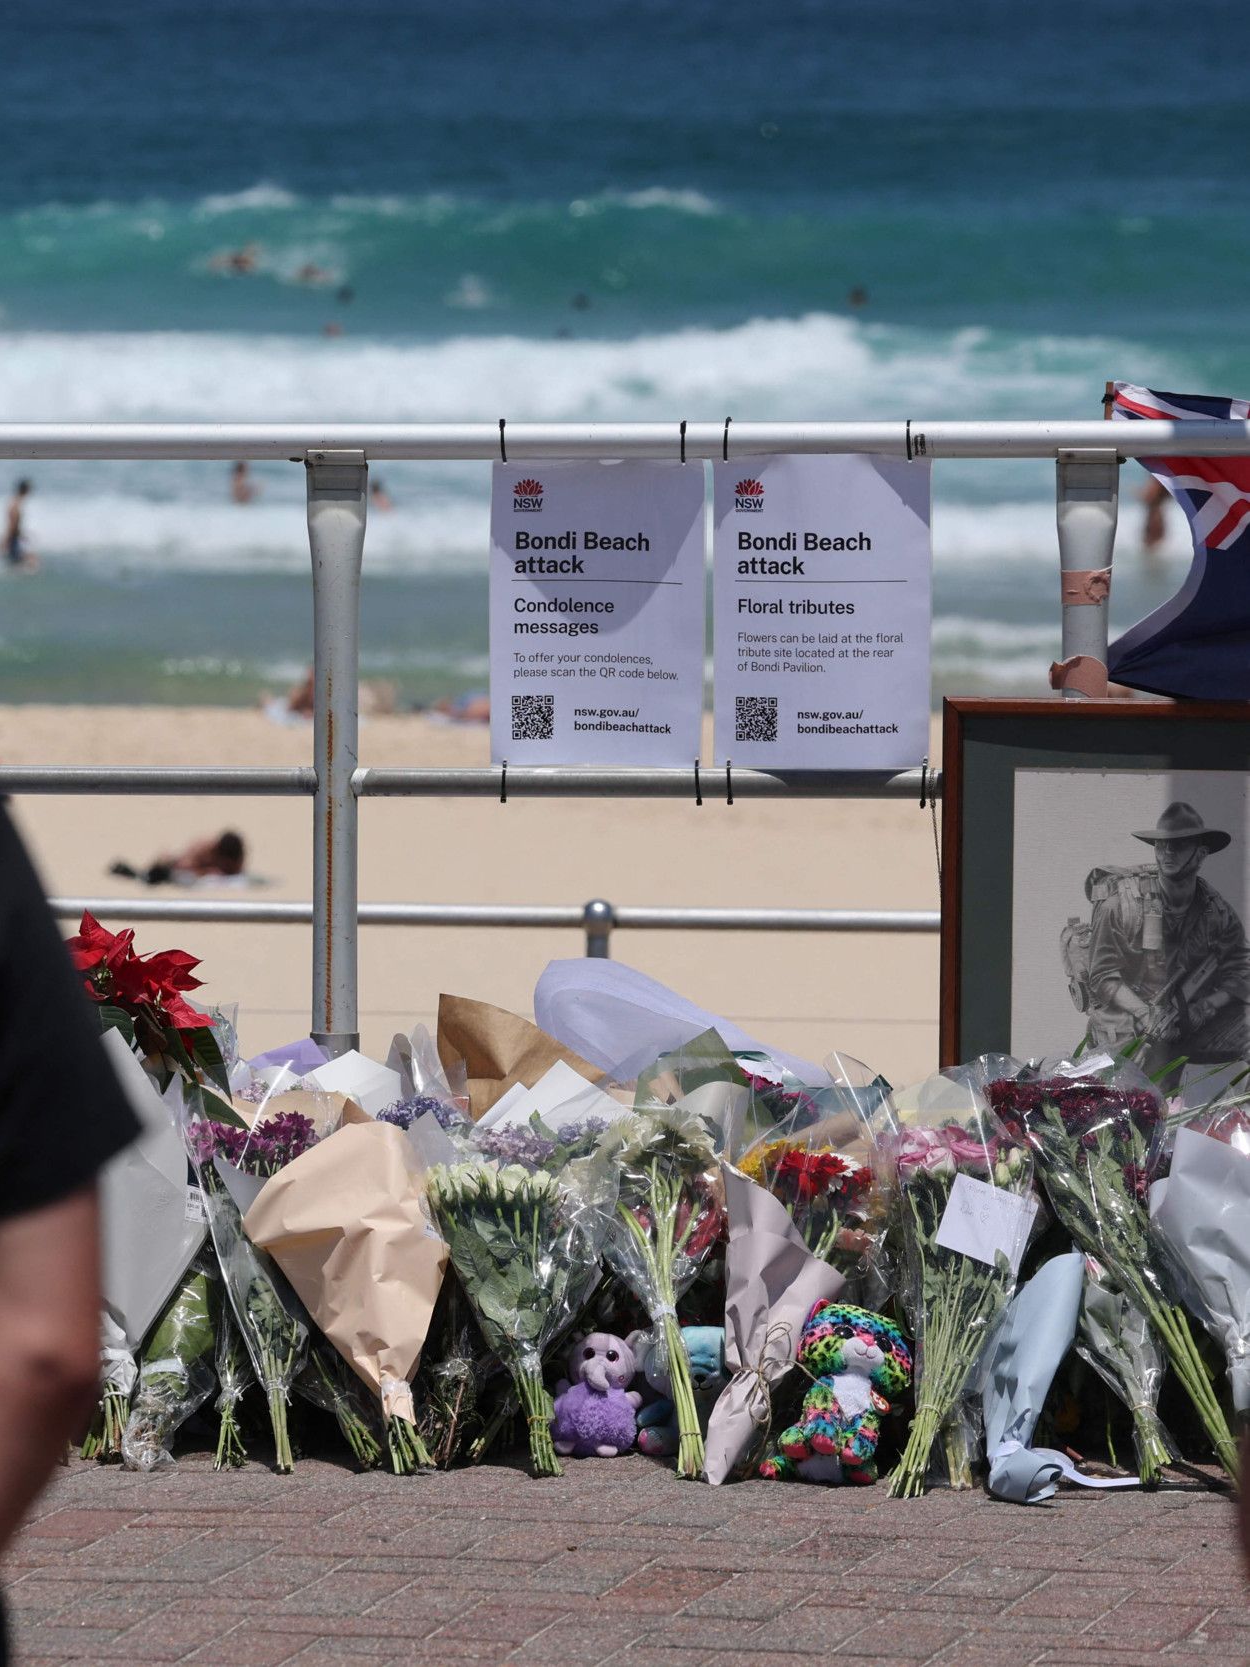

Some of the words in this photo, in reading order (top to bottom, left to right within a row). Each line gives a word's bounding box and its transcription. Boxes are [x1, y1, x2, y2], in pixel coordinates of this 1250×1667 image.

[514, 498, 543, 508] NSW
[736, 498, 764, 508] NSW
[515, 531, 577, 550] Bondi
[584, 532, 650, 551] Beach
[738, 532, 797, 550] Bondi
[804, 532, 871, 551] Beach
[514, 555, 584, 573] attack
[737, 556, 805, 575] attack
[514, 597, 614, 613] Condolence
[738, 598, 783, 614] Floral
[789, 599, 855, 615] tributes
[514, 622, 599, 637] messages
[737, 632, 777, 643] Flowers
[780, 635, 799, 643] can
[802, 633, 815, 643] be
[818, 633, 838, 643] laid
[841, 634, 852, 643] at
[855, 633, 873, 643] the
[876, 633, 904, 643] floral
[513, 652, 526, 663] To
[528, 652, 554, 663] offer
[557, 655, 581, 664] your
[584, 653, 653, 665] condolences,
[738, 647, 771, 657] tribute
[774, 648, 792, 657] site
[795, 648, 835, 658] located
[838, 649, 849, 658] at
[852, 648, 870, 658] the
[873, 649, 894, 658] rear
[513, 667, 548, 679] please
[550, 669, 576, 677] scan
[579, 667, 597, 677] the
[599, 667, 616, 679] QR
[618, 669, 645, 679] code
[647, 669, 679, 681] below.
[737, 662, 748, 671] of
[751, 662, 780, 672] Bondi
[783, 662, 826, 673] Pavilion.
[574, 708, 640, 719] nsw.gov.au/
[797, 709, 864, 721] nsw.gov.au/
[574, 720, 672, 734] bondibeachattack
[797, 722, 900, 734] bondibeachattack
